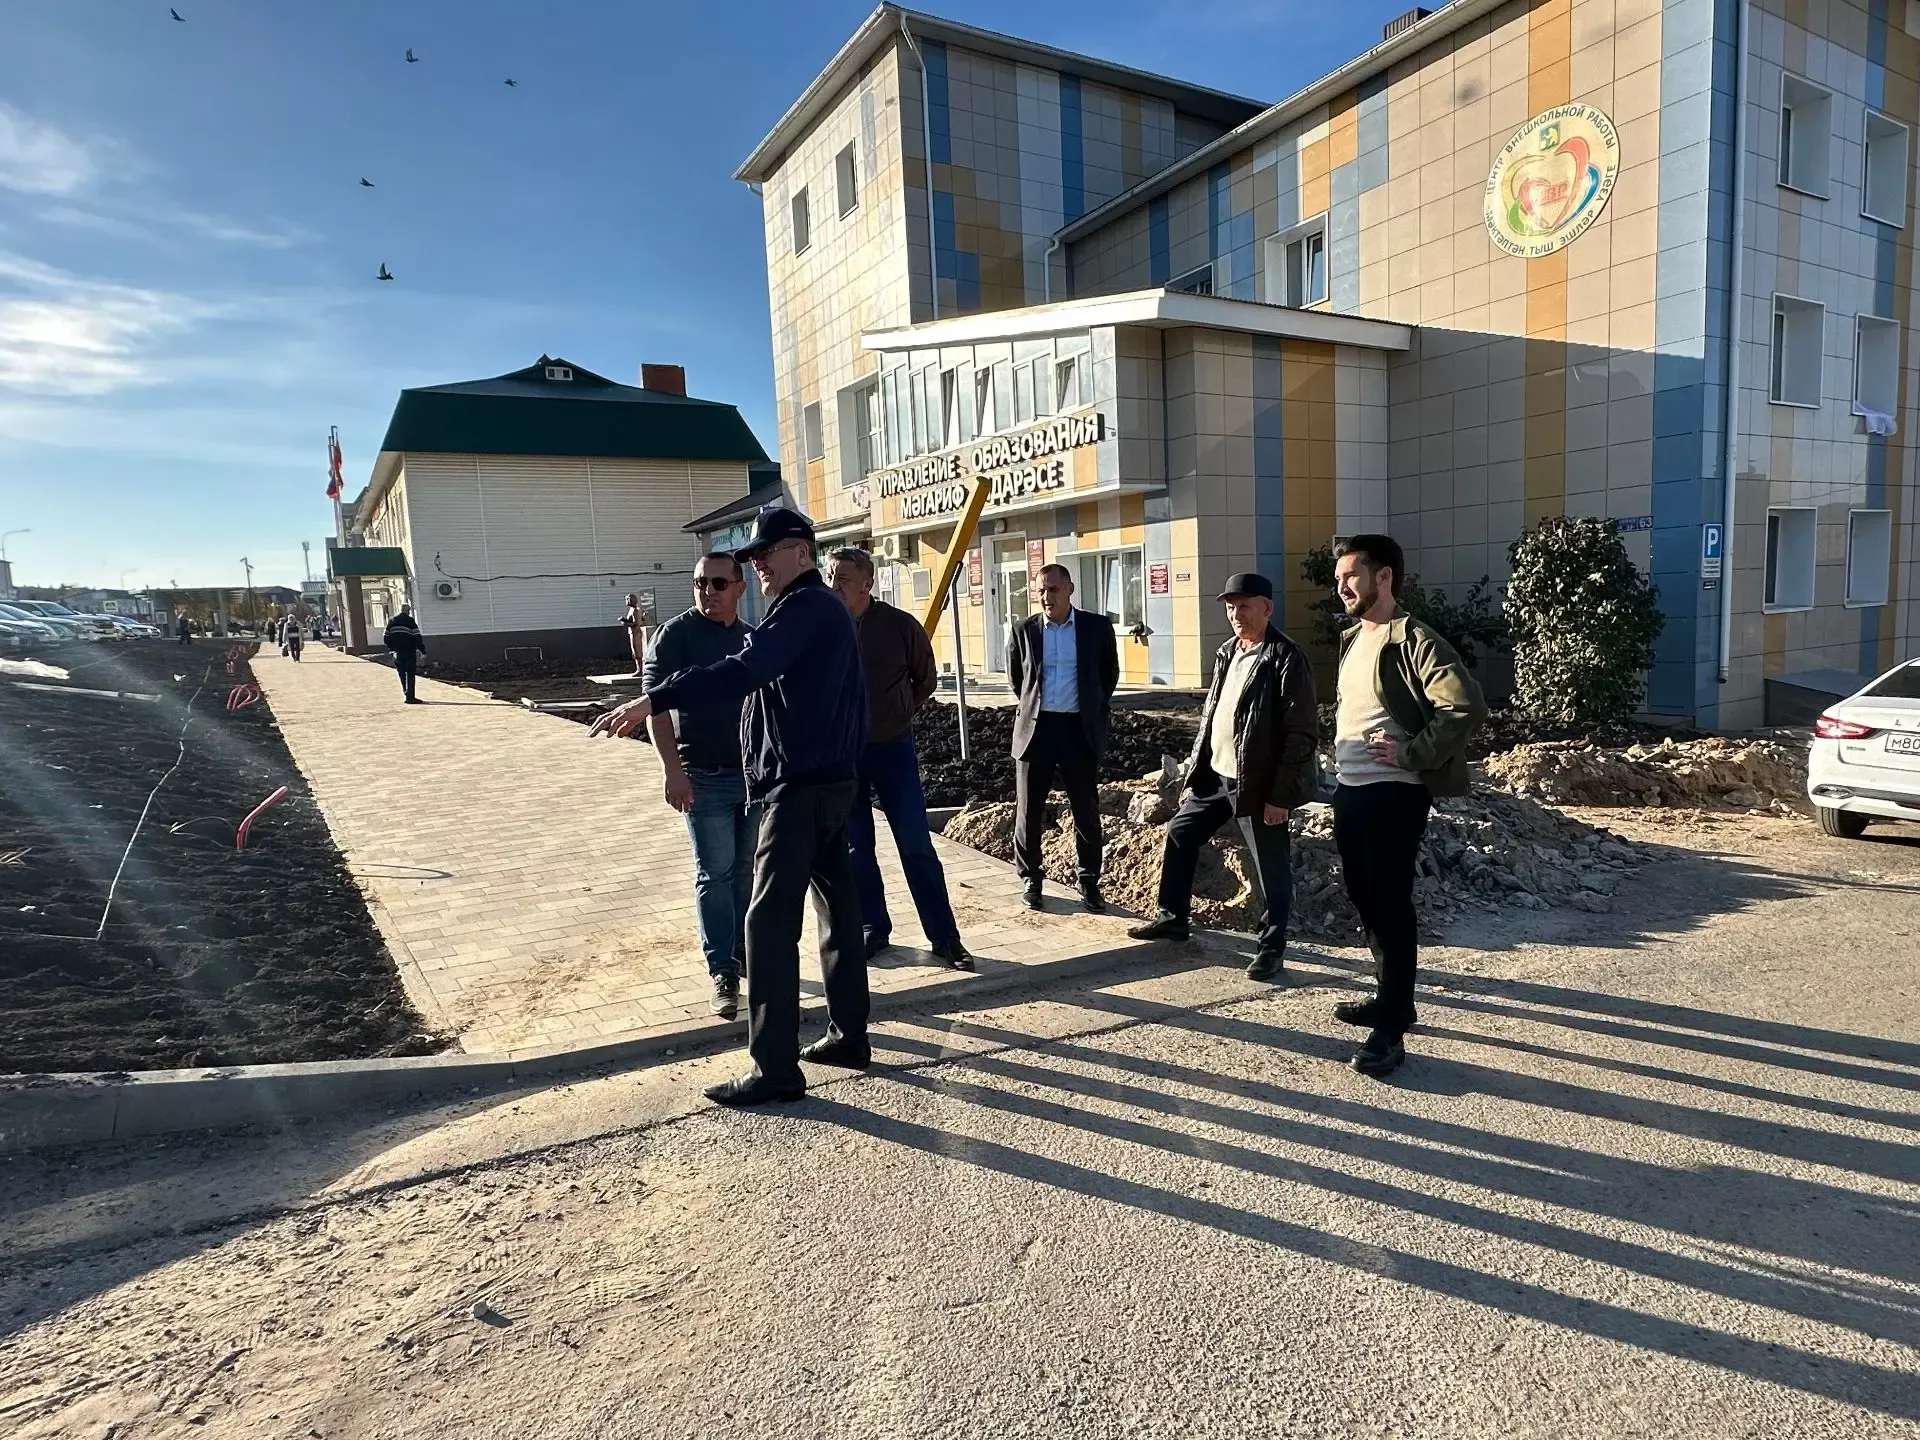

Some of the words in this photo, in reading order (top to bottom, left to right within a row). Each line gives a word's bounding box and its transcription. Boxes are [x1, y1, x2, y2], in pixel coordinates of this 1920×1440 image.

[1487, 157, 1504, 196] ЦЕНТР
[1504, 105, 1586, 154] ВНЕШКОЛЬНОЙ
[1586, 111, 1616, 149] РАБОТЫ
[875, 456, 957, 499] УПРАВЛЕНИЕ
[971, 413, 1099, 473] ОБРАЗОВАНИЯ
[986, 461, 1060, 504] ДАРӘСЕ
[1637, 517, 1653, 528] 63
[1706, 528, 1719, 556] P
